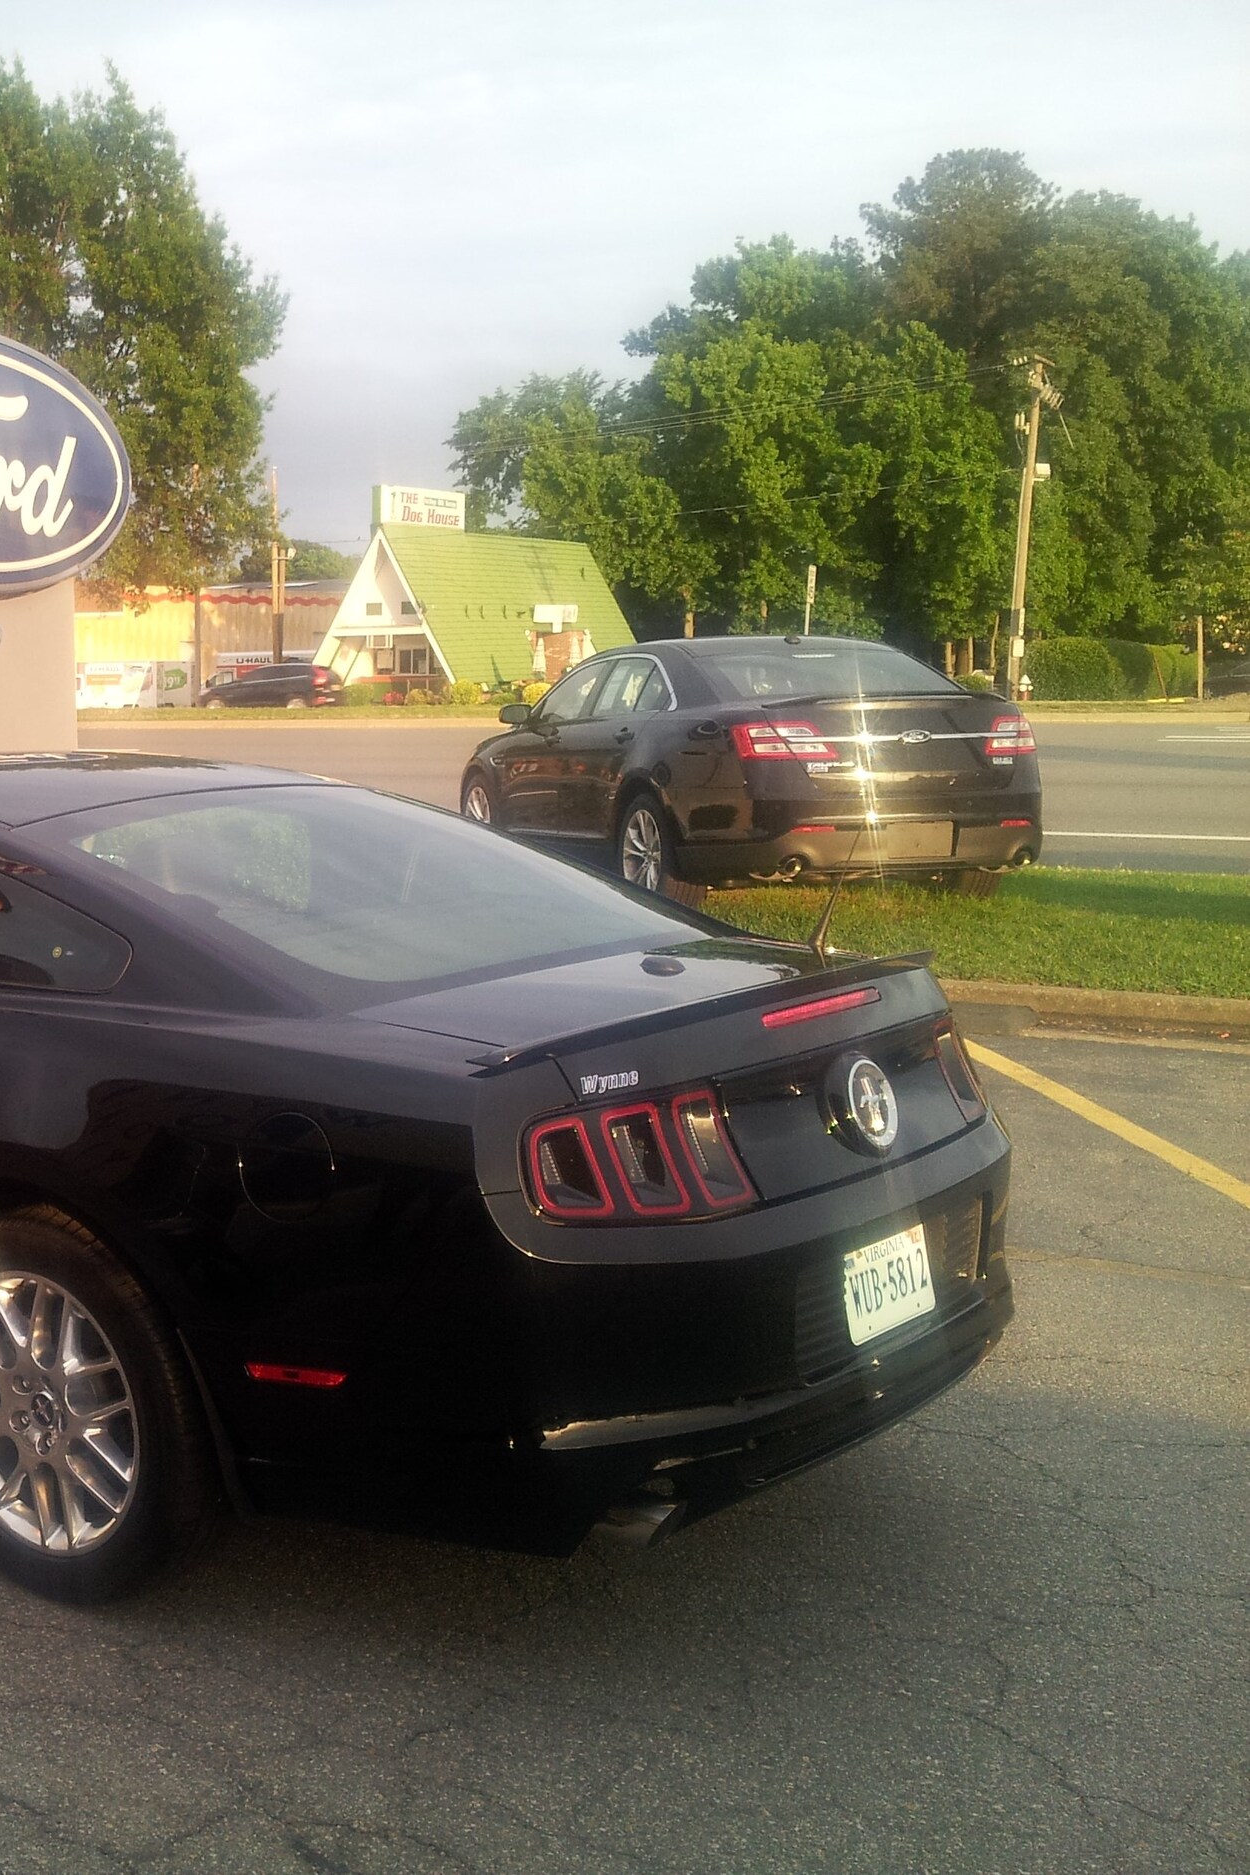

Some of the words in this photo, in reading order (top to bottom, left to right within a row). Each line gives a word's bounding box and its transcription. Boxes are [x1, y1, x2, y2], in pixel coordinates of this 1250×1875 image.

[400, 492, 419, 504] THE
[401, 505, 423, 523] DOG
[427, 508, 460, 526] HOUSE
[580, 1070, 639, 1095] Wynne
[863, 1236, 905, 1263] VIRGINIA
[849, 1248, 928, 1319] WUB-5812
